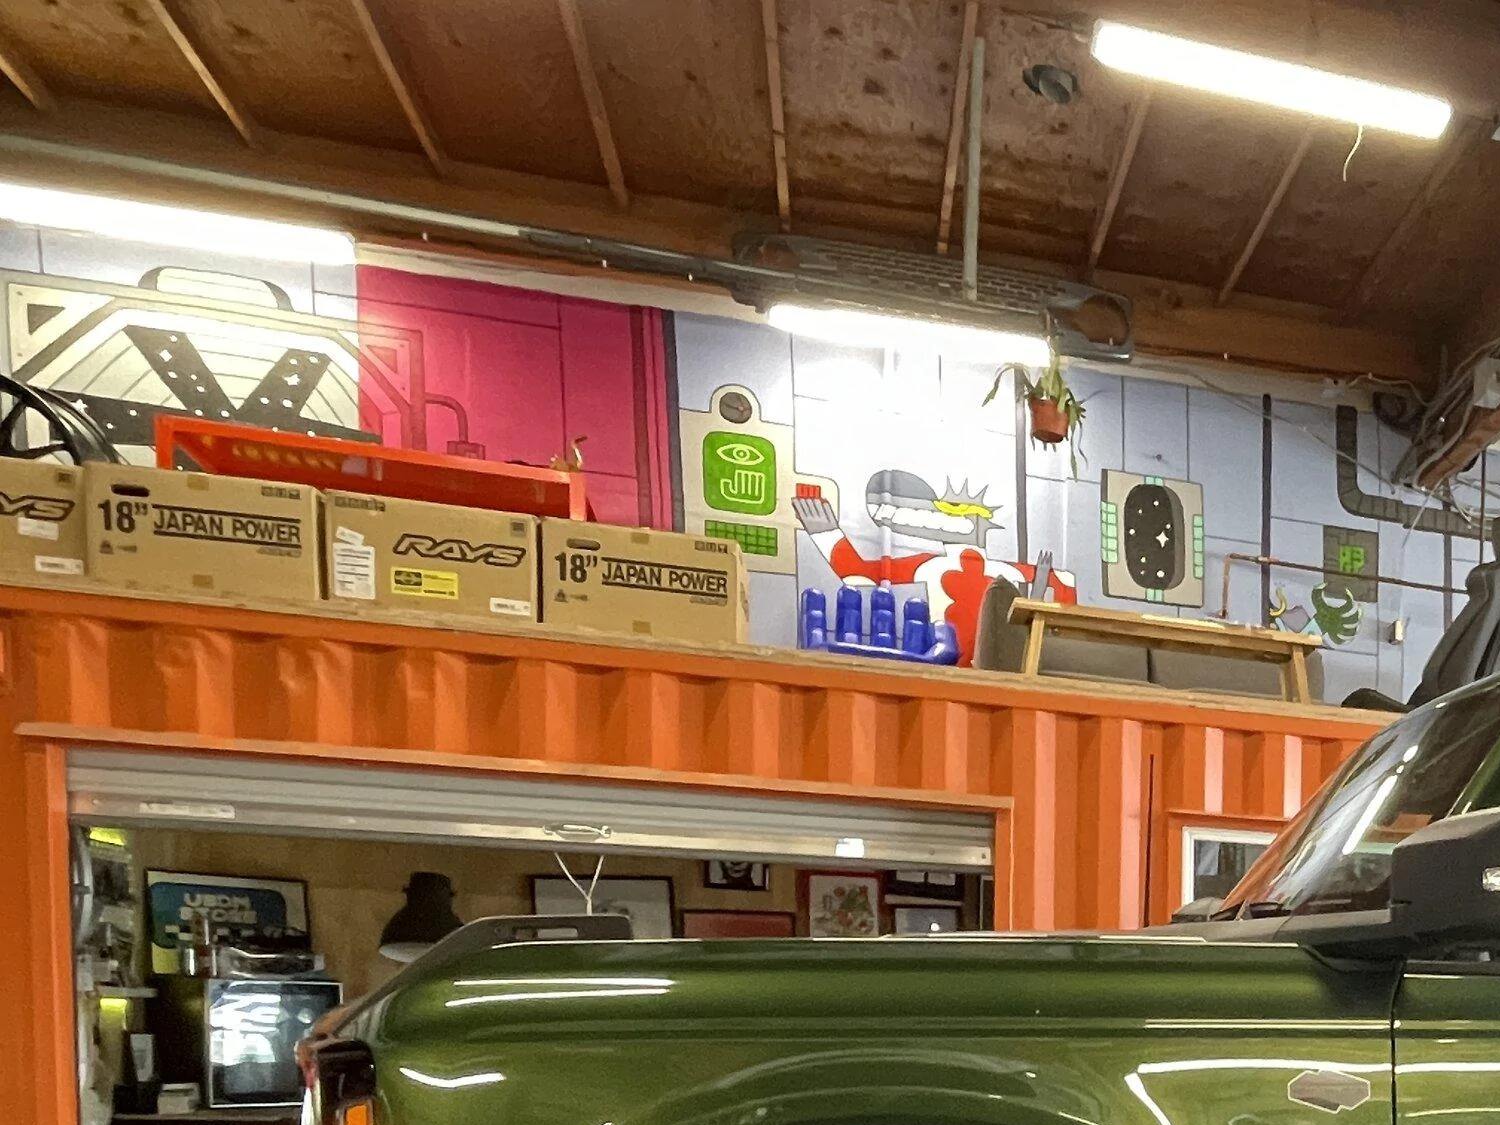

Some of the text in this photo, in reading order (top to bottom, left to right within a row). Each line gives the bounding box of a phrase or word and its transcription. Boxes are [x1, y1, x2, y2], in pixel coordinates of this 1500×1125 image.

[153, 510, 224, 536] JAPAN
[232, 518, 301, 543] POWER
[392, 533, 527, 567] RAYS
[602, 561, 662, 587] JAPAN
[668, 571, 728, 594] POWER
